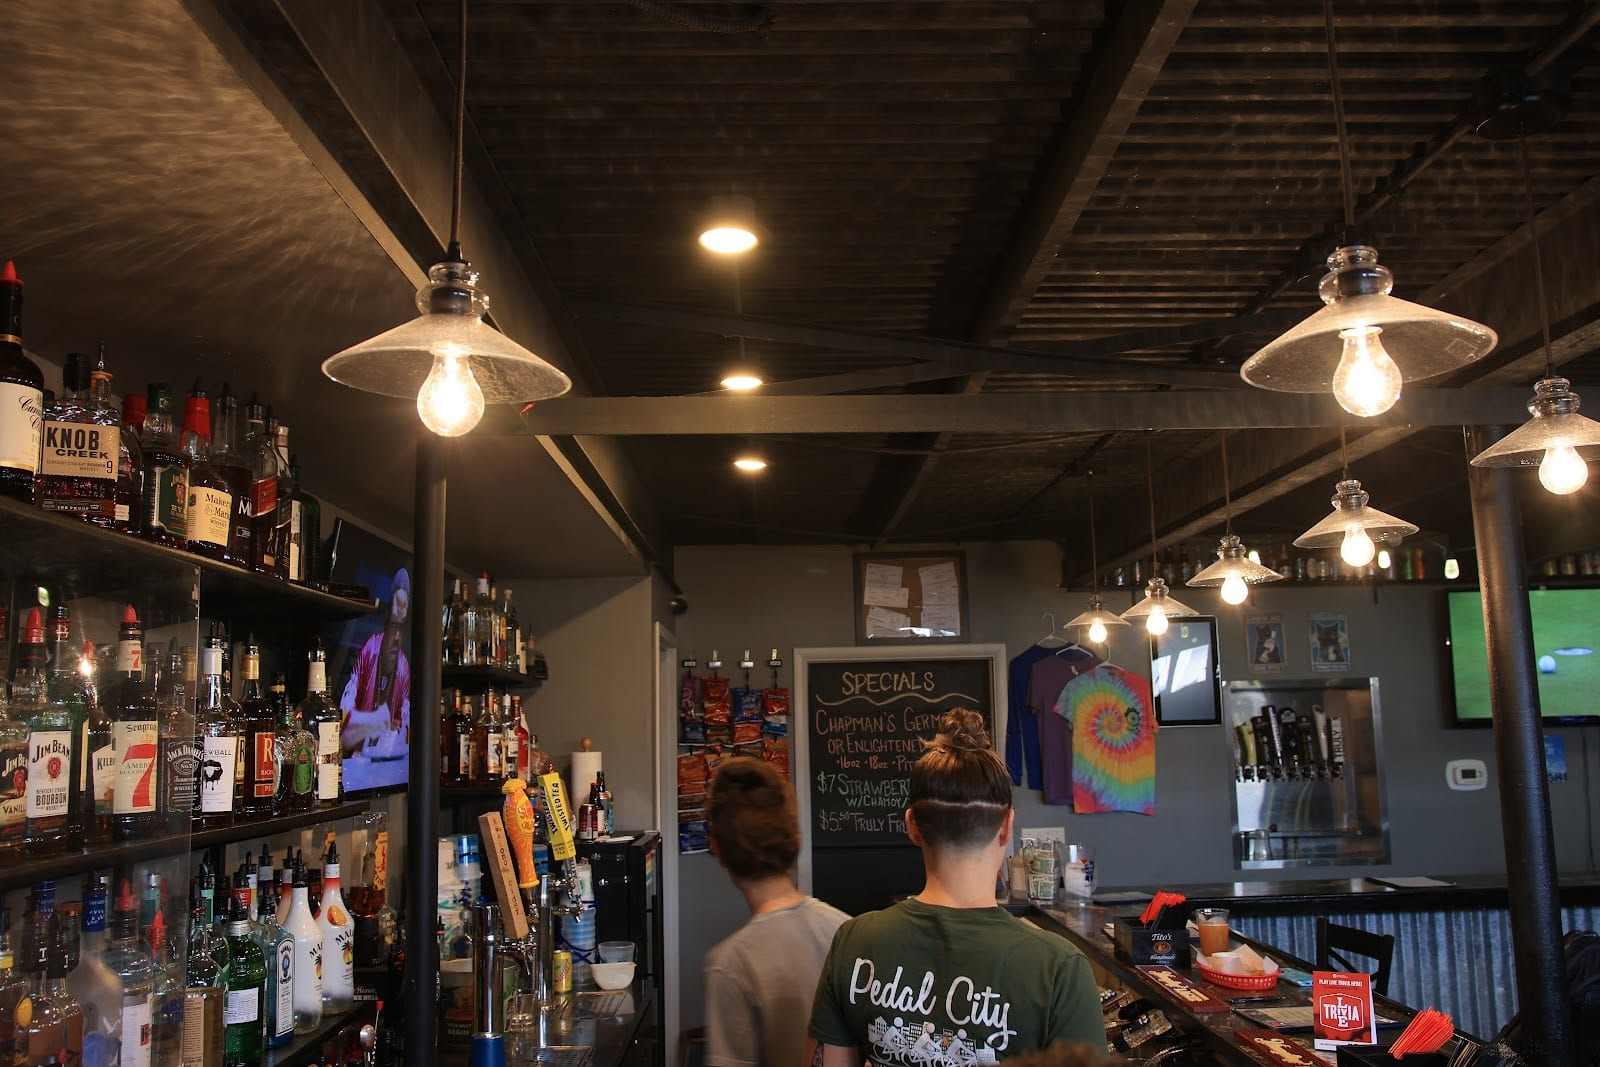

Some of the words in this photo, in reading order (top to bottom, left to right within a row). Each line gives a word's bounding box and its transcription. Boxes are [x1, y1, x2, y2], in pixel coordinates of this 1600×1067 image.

[46, 427, 100, 450] KNOB
[56, 449, 109, 459] CREEK
[106, 460, 113, 474] 9
[841, 672, 935, 695] SPECIALS
[815, 708, 896, 735] CHAPMAN'S
[32, 743, 51, 763] JIM
[827, 739, 844, 755] OR
[1331, 730, 1343, 759] TRULY
[167, 750, 181, 762] JACK
[896, 755, 913, 772] PIT
[1, 757, 18, 777] JIM
[122, 743, 158, 808] 7
[552, 782, 560, 798] TEA
[817, 771, 835, 794] $7
[36, 793, 67, 806] BOURBON
[542, 799, 559, 835] TWISTED
[555, 797, 570, 831] TWISTED
[850, 812, 885, 833] TRULY
[1151, 933, 1173, 941] Tito's
[849, 957, 936, 1016] Pedal
[945, 976, 1018, 1052] City
[1323, 1003, 1360, 1021] TRIVIA
